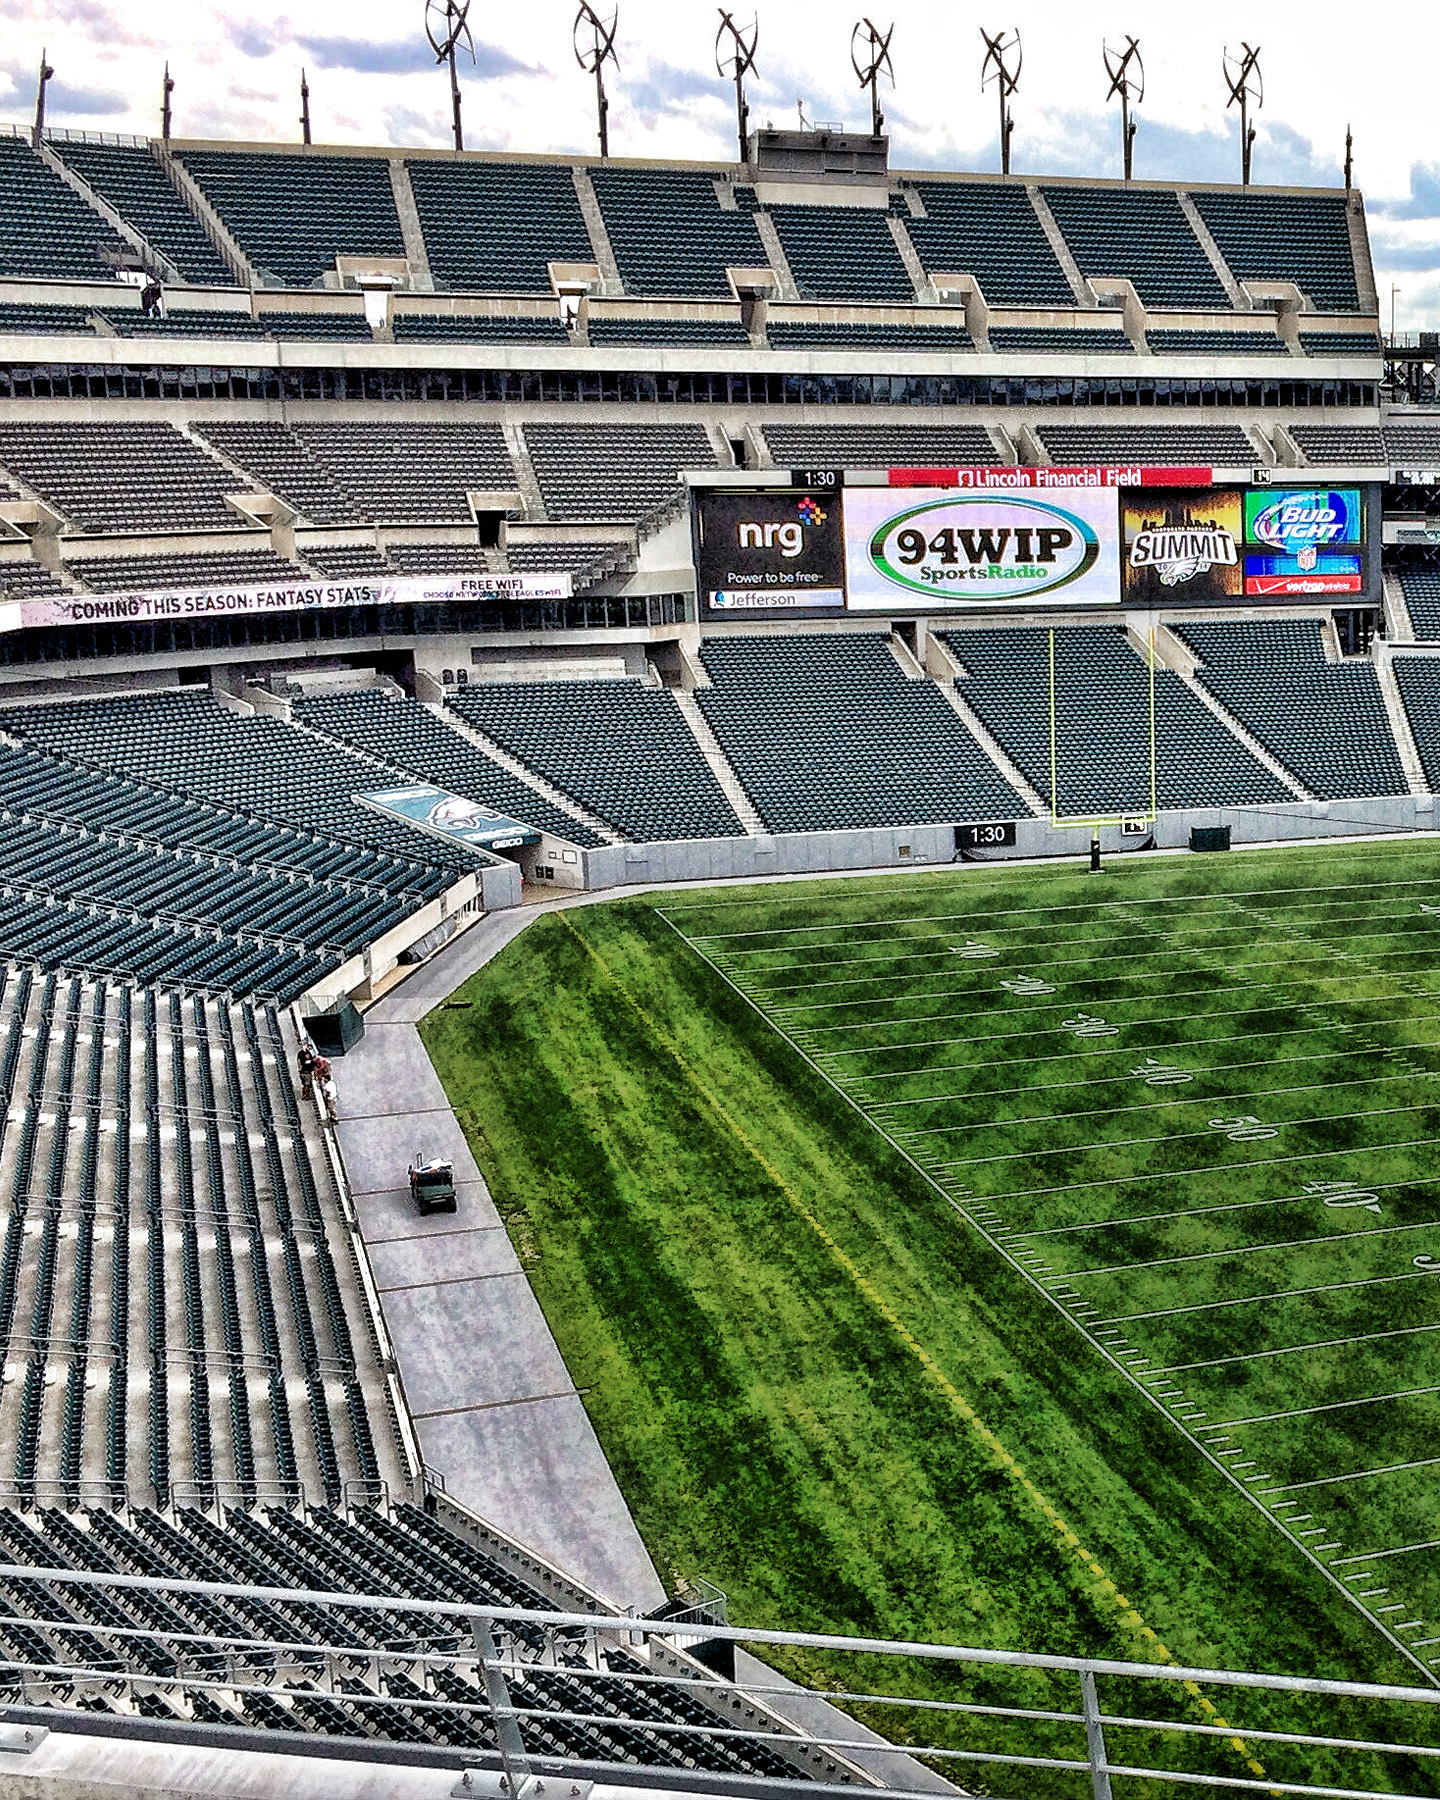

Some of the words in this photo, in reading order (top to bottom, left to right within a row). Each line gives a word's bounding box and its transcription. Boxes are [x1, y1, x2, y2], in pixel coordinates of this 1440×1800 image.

[804, 472, 835, 485] 1:30
[976, 470, 1031, 486] Lincoln
[1036, 469, 1101, 486] Financial
[1106, 468, 1142, 486] Field
[1281, 507, 1337, 523] BUD
[739, 522, 804, 557] nrg
[1269, 523, 1344, 538] LIGHT
[897, 527, 1074, 565] 94WIP
[1133, 533, 1231, 564] SUMMIT
[727, 572, 763, 583] Power
[765, 571, 778, 583] to
[780, 571, 795, 583] be
[920, 563, 1049, 584] SportsRadio
[461, 580, 493, 591] FREE
[496, 579, 524, 590] WIFI
[72, 602, 140, 620] COMING
[146, 598, 180, 614] THIS
[184, 592, 254, 612] SEASON:
[256, 588, 324, 607] FANTASY
[327, 586, 370, 602] STATS
[730, 593, 797, 607] Jefferson
[970, 826, 1005, 842] 1:30
[1207, 1115, 1280, 1142] 50
[1301, 1179, 1380, 1209] 40
